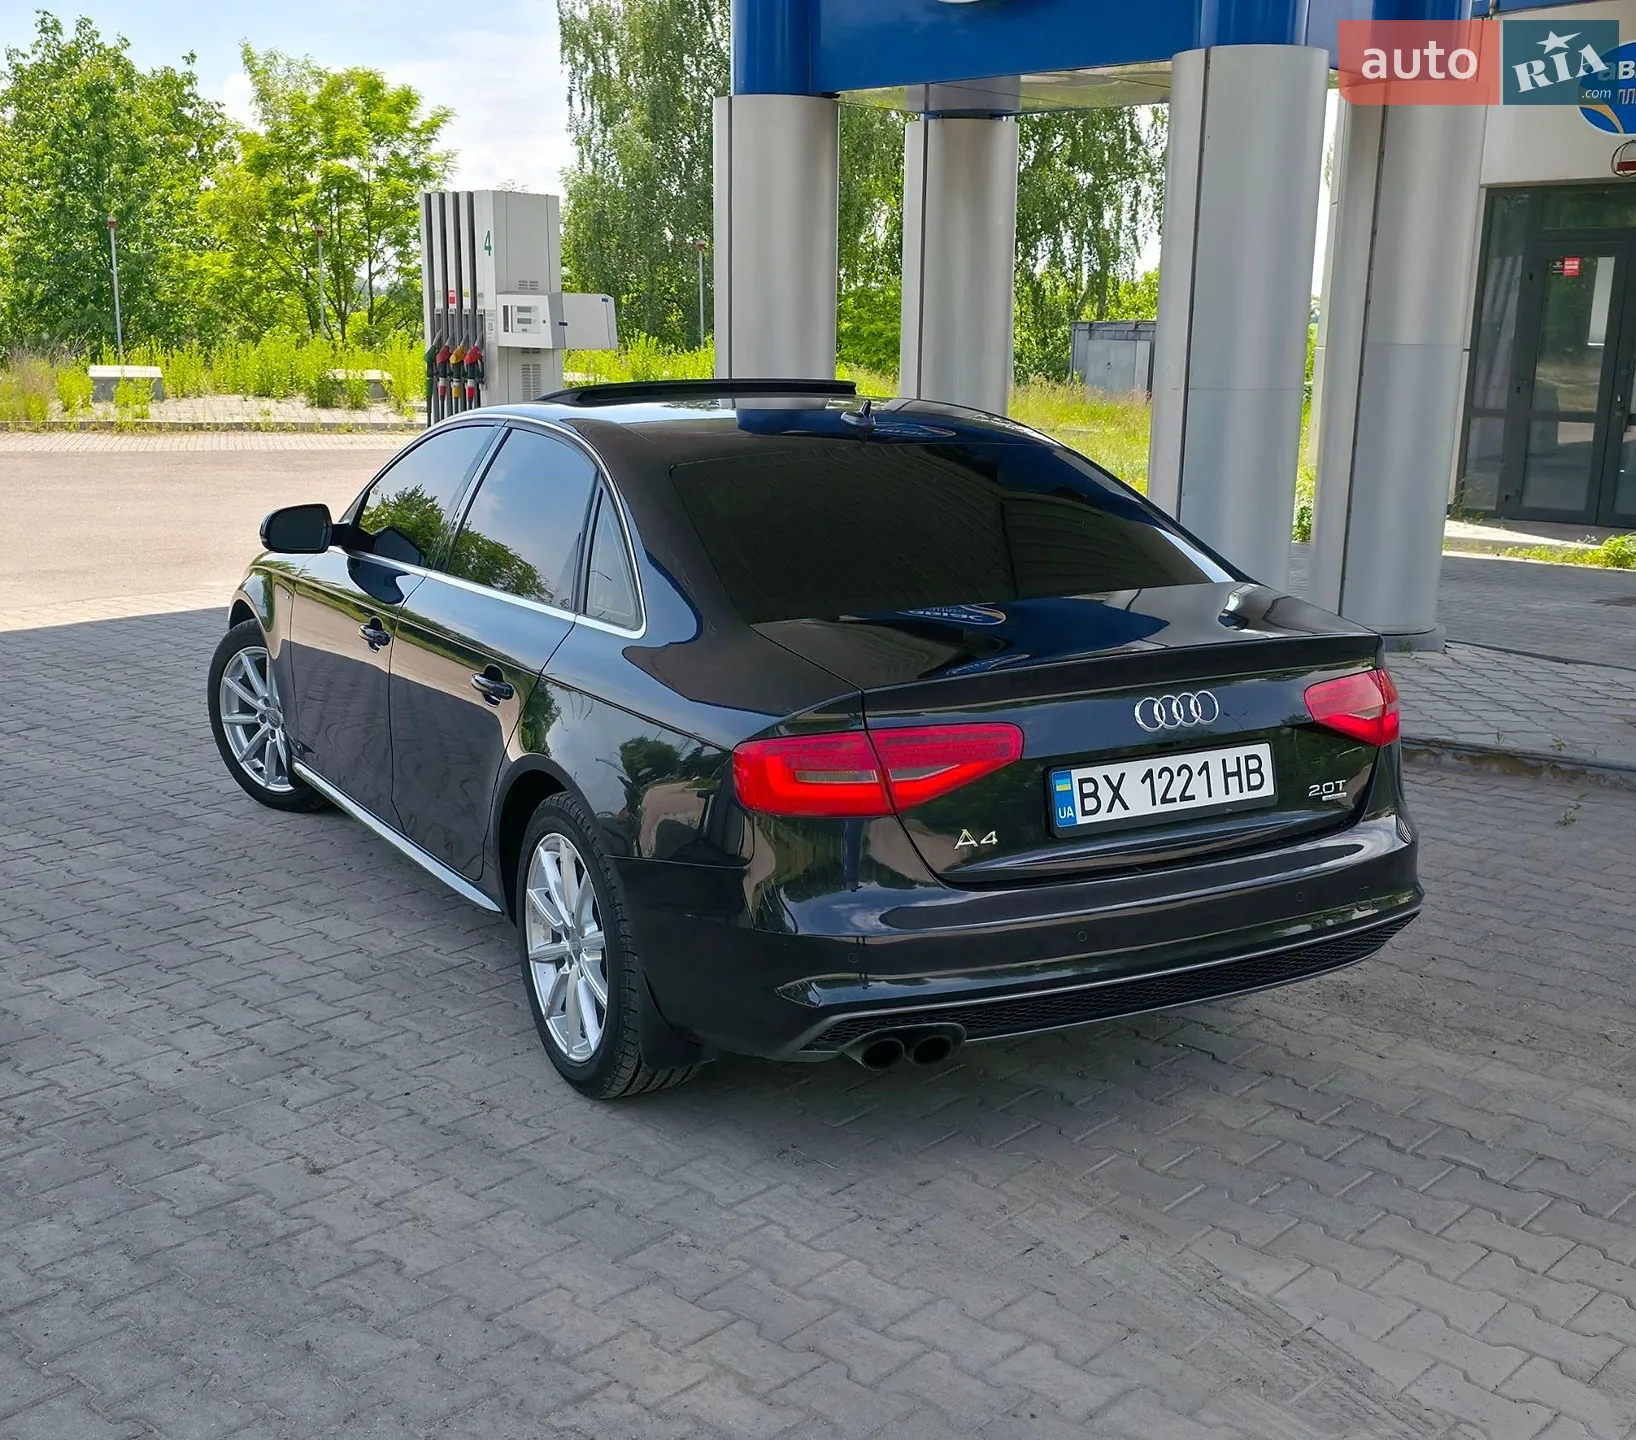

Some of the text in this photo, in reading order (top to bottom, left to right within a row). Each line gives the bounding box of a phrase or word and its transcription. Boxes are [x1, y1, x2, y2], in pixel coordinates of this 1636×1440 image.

[484, 230, 492, 256] 4
[1078, 753, 1265, 817] BX 1221 HB
[1309, 779, 1347, 797] 2.0T
[1058, 806, 1075, 819] UA
[953, 828, 998, 850] A4
